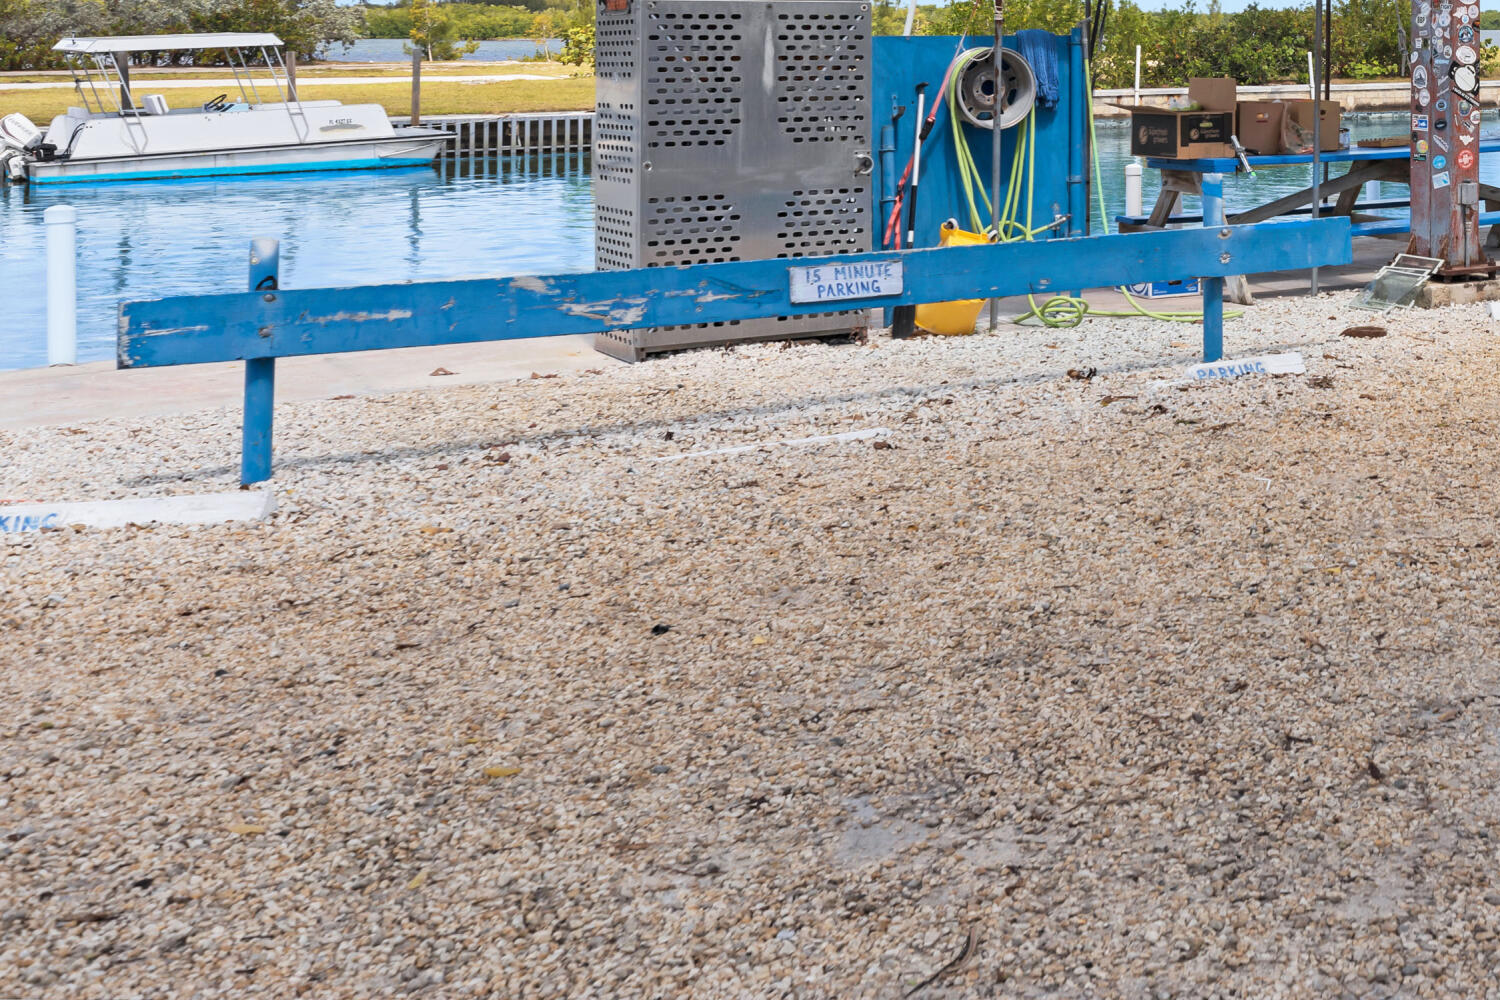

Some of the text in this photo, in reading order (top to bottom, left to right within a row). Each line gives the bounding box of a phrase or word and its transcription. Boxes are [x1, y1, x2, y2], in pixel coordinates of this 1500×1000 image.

[806, 263, 893, 284] 15 MINUTE
[817, 280, 882, 299] PARKING
[1196, 361, 1266, 380] PARKING
